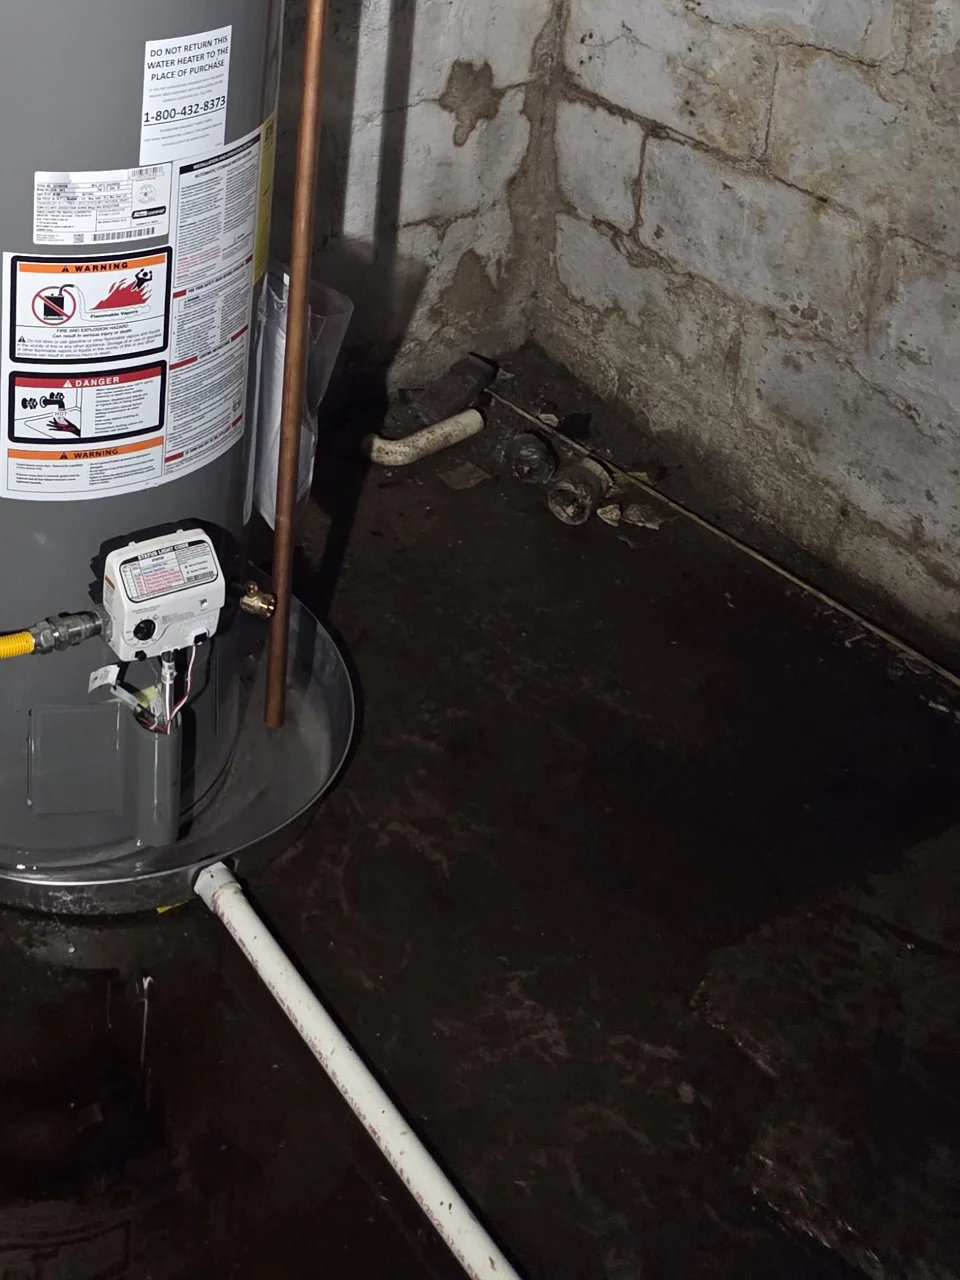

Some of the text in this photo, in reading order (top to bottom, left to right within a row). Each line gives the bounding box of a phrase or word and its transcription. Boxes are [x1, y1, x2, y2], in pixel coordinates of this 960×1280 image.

[150, 35, 228, 57] DO NOT RETURN THIS
[147, 46, 229, 69] WATER HEATER TO THE
[151, 59, 224, 80] PLACE OF PURCHASE
[144, 96, 226, 123] 1-800-432-8373
[74, 262, 129, 272] WARNING
[76, 376, 119, 387] DANGER
[74, 449, 118, 459] WARNING
[138, 551, 158, 560] STATUS
[158, 547, 174, 555] LIGHT
